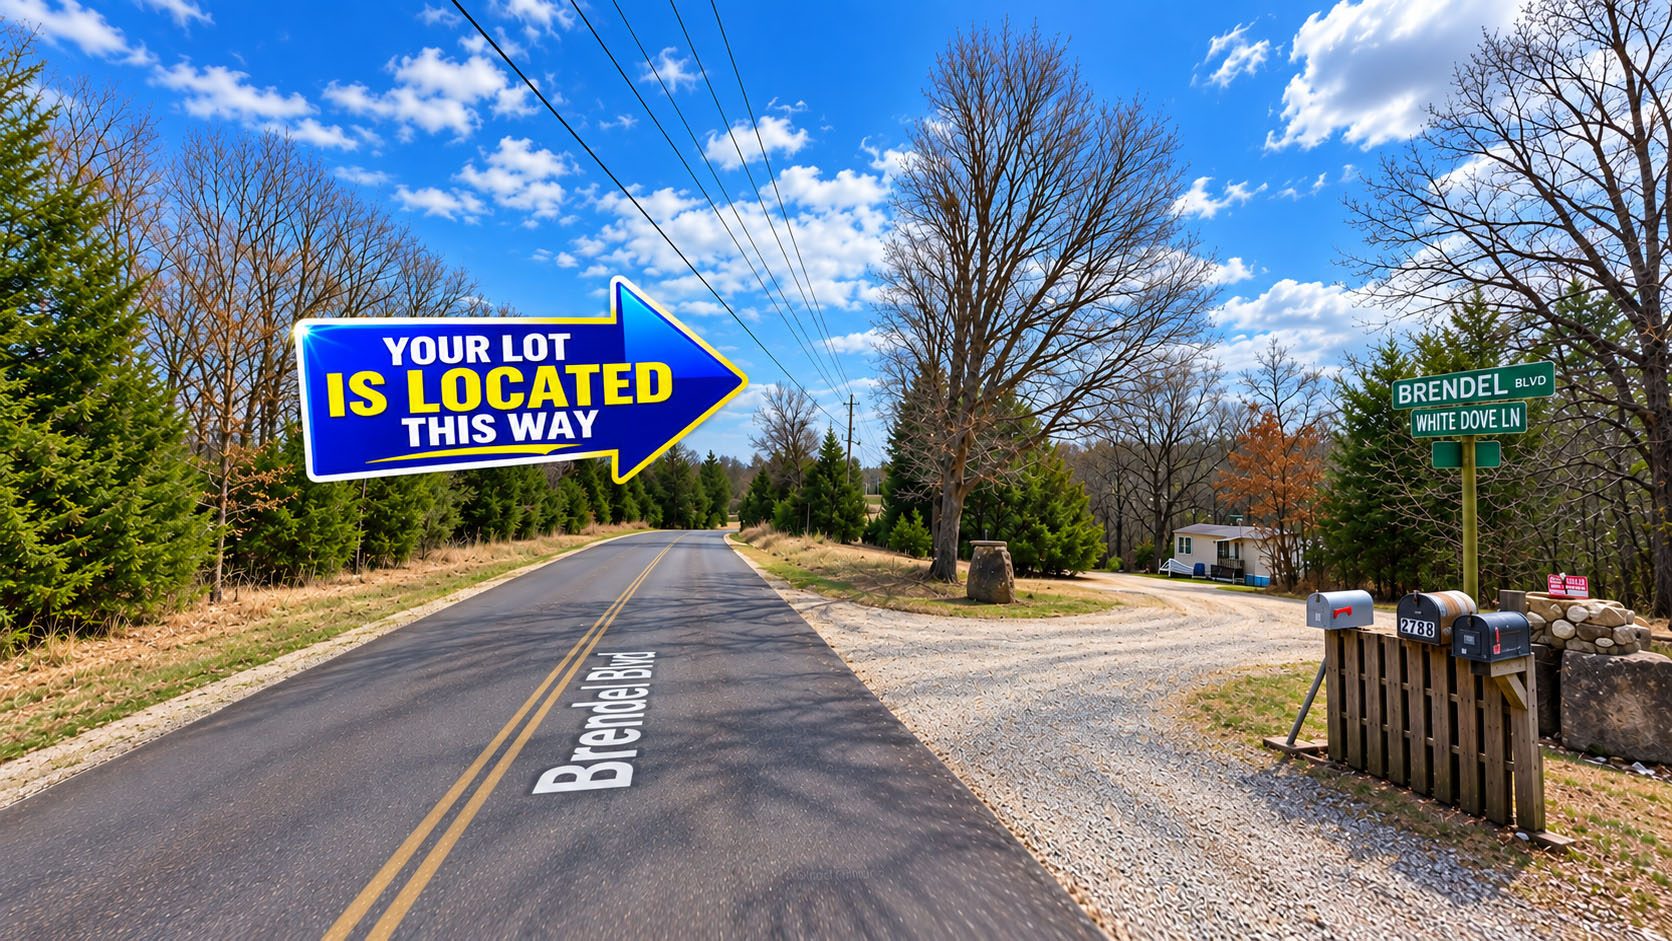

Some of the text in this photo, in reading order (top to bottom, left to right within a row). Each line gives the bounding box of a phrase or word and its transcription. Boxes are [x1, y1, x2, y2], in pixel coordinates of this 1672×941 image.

[1399, 373, 1547, 404] BRENDEL BLVD
[1416, 407, 1520, 432] WHITE DOVE LN
[1401, 619, 1434, 637] 2788
